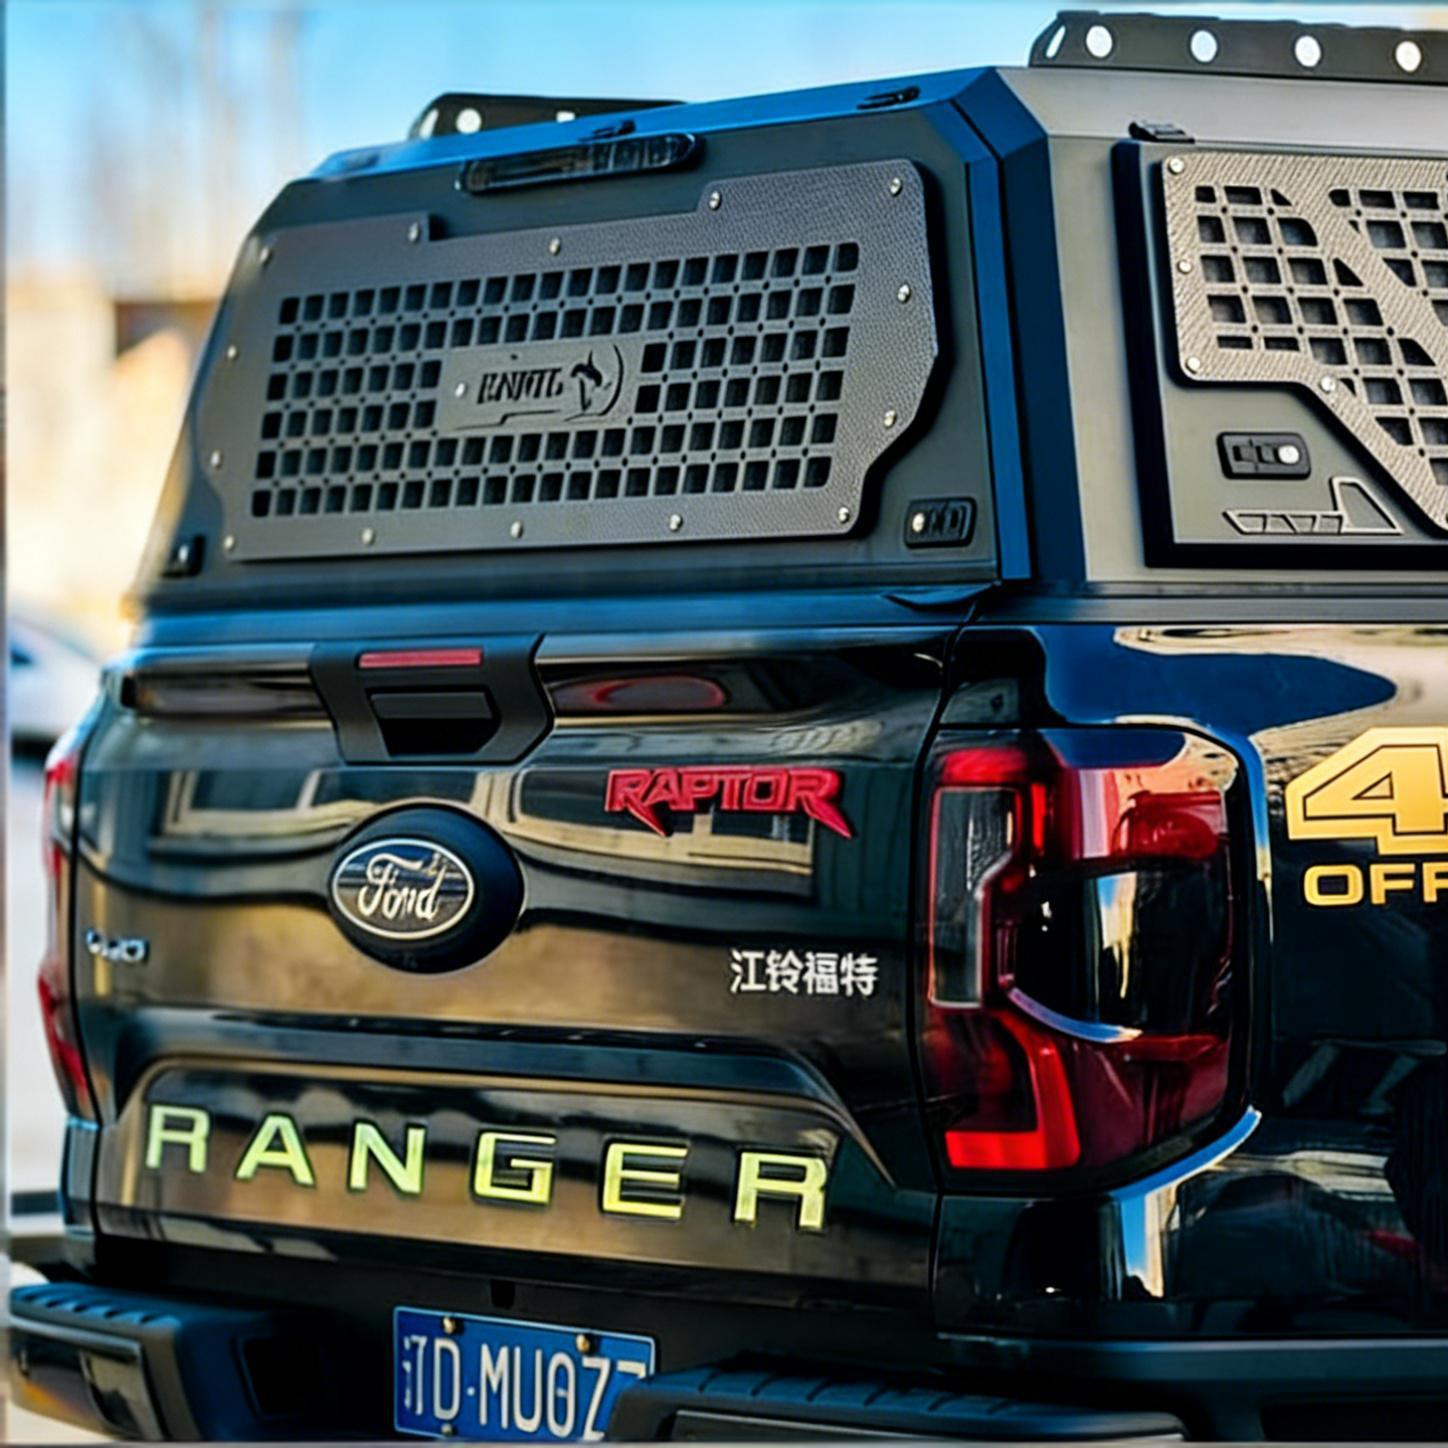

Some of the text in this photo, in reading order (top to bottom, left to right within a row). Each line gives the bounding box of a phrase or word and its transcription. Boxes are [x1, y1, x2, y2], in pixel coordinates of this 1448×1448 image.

[604, 765, 852, 838] RAPTOR
[358, 853, 447, 921] Ford
[730, 948, 878, 996] 江铃福特
[146, 1105, 829, 1229] RANGER
